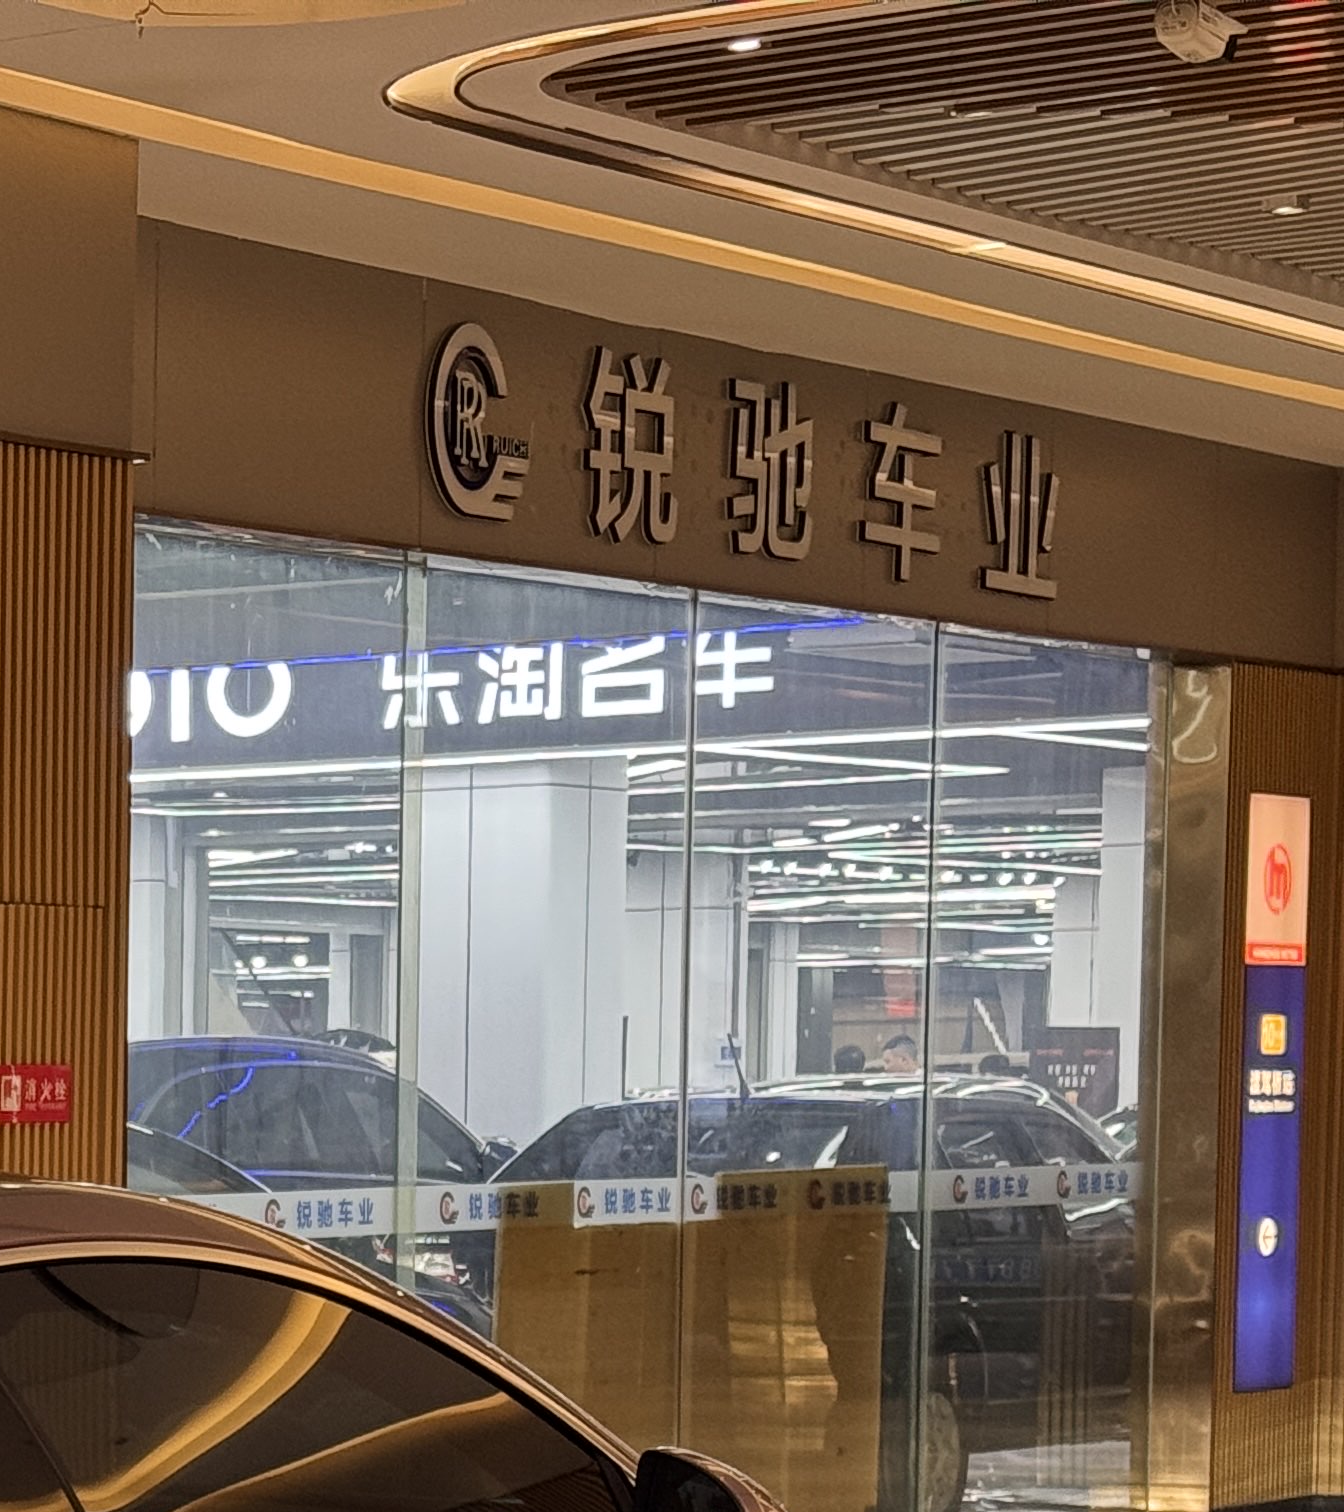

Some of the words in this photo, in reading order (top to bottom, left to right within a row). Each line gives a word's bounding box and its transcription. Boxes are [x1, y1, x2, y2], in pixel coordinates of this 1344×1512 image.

[581, 345, 1060, 600] 锐驰车业
[24, 1078, 67, 1103] 消火栓
[974, 1174, 1029, 1200] 锐驰车业
[1077, 1170, 1129, 1195] 锐驰车业
[296, 1199, 374, 1229] 锐驰车业
[468, 1191, 540, 1221] 锐驰车业
[604, 1186, 672, 1215] 锐驰车业
